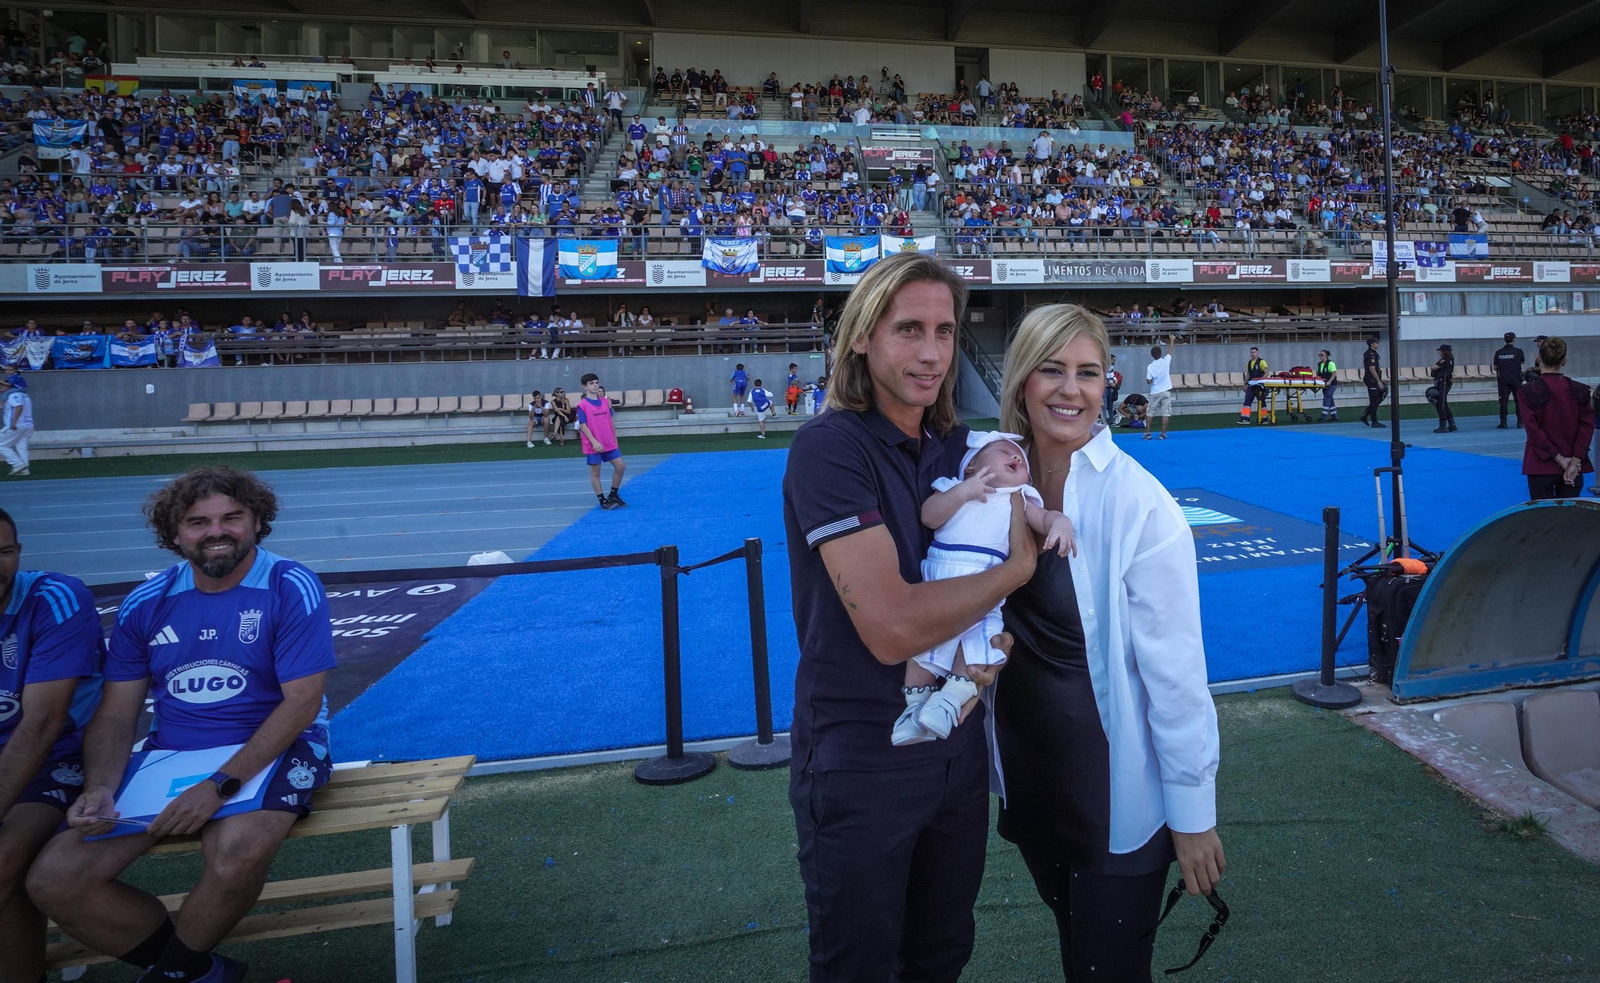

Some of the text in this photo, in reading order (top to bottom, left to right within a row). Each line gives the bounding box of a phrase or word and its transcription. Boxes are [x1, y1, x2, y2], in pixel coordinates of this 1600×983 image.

[112, 267, 227, 288] PLAY JEREZ
[328, 266, 434, 286] PLAY JEREZ
[749, 263, 806, 282] JEREZ
[1095, 266, 1107, 276] DE
[1111, 266, 1146, 276] CALIDA
[1200, 262, 1272, 279] PLAY JEREZ
[1336, 266, 1367, 275] PLAY
[1460, 264, 1521, 279] PLAY JEREZ
[1574, 267, 1600, 275] PLAY
[199, 629, 218, 640] J.P.
[165, 659, 249, 681] DISTRIBUCIONES CÁRNICAS
[173, 675, 244, 694] LUGO
